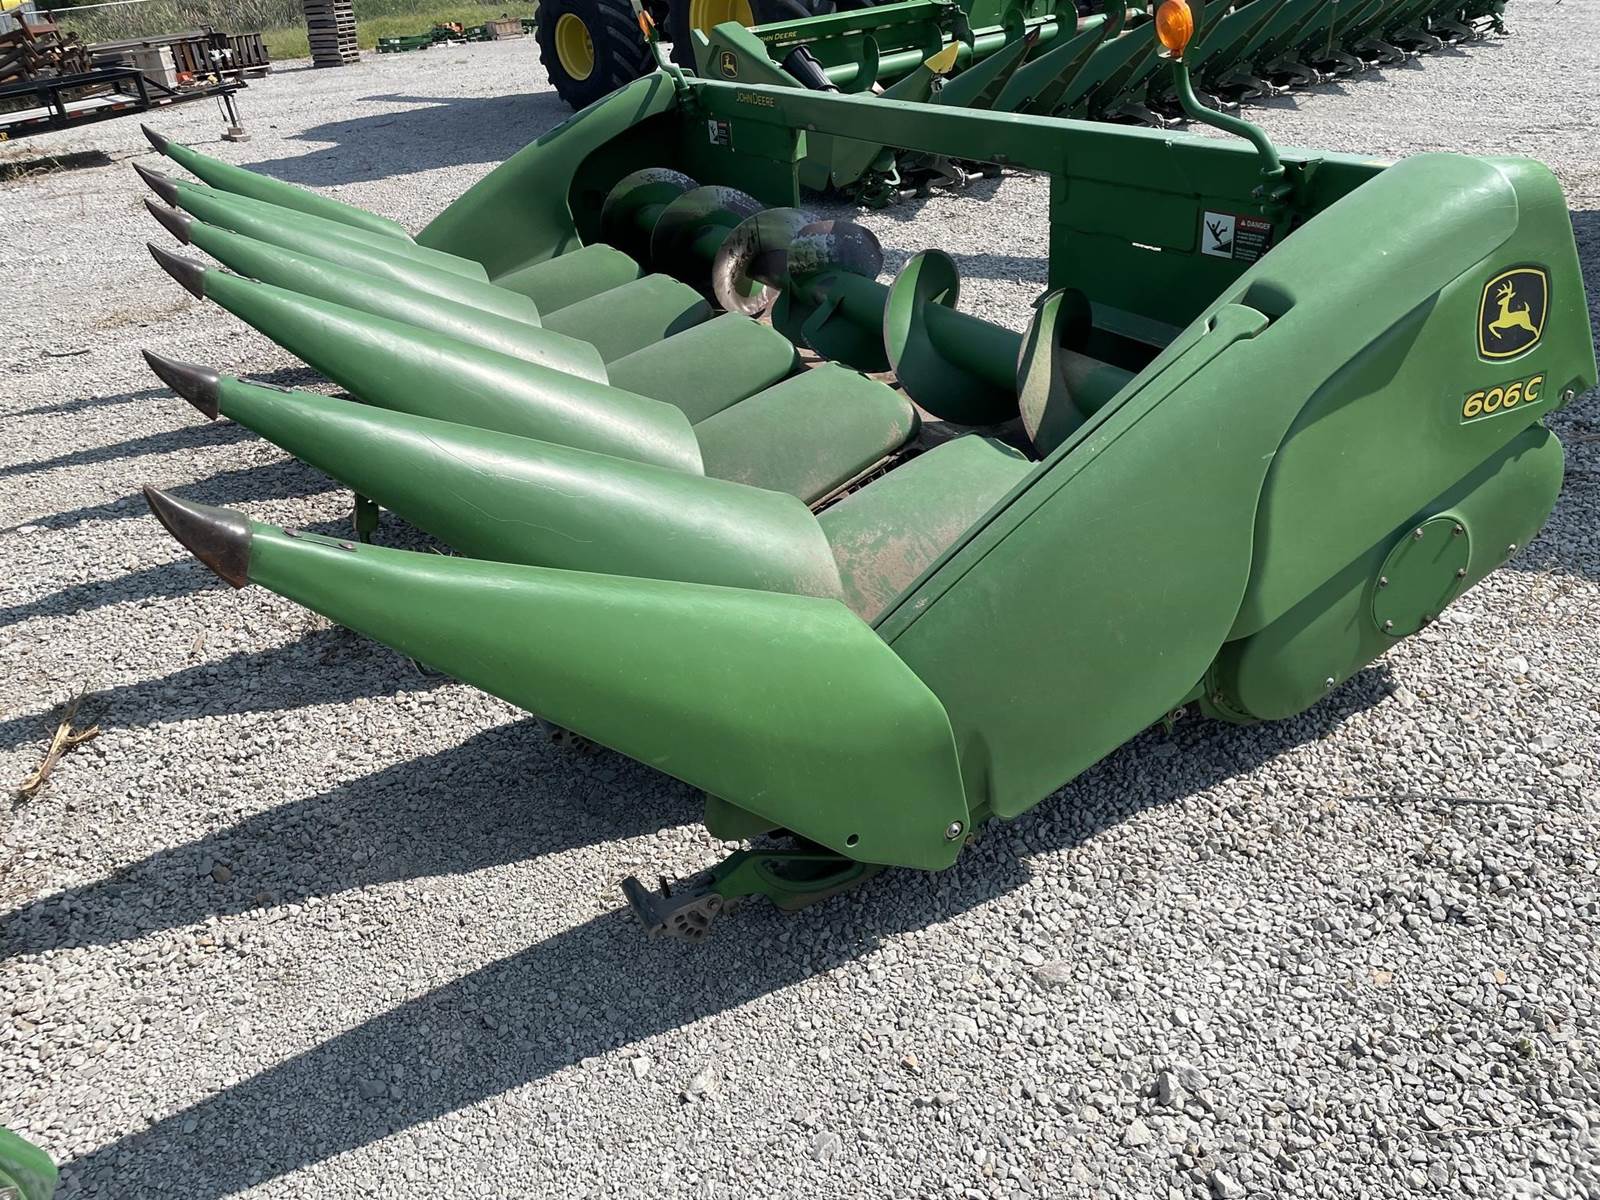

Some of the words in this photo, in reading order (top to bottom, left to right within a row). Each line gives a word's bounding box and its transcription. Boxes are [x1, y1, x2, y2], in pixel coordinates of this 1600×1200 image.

[774, 30, 798, 40] DEERE
[752, 92, 775, 107] DEERE
[1462, 375, 1544, 418] 606C
